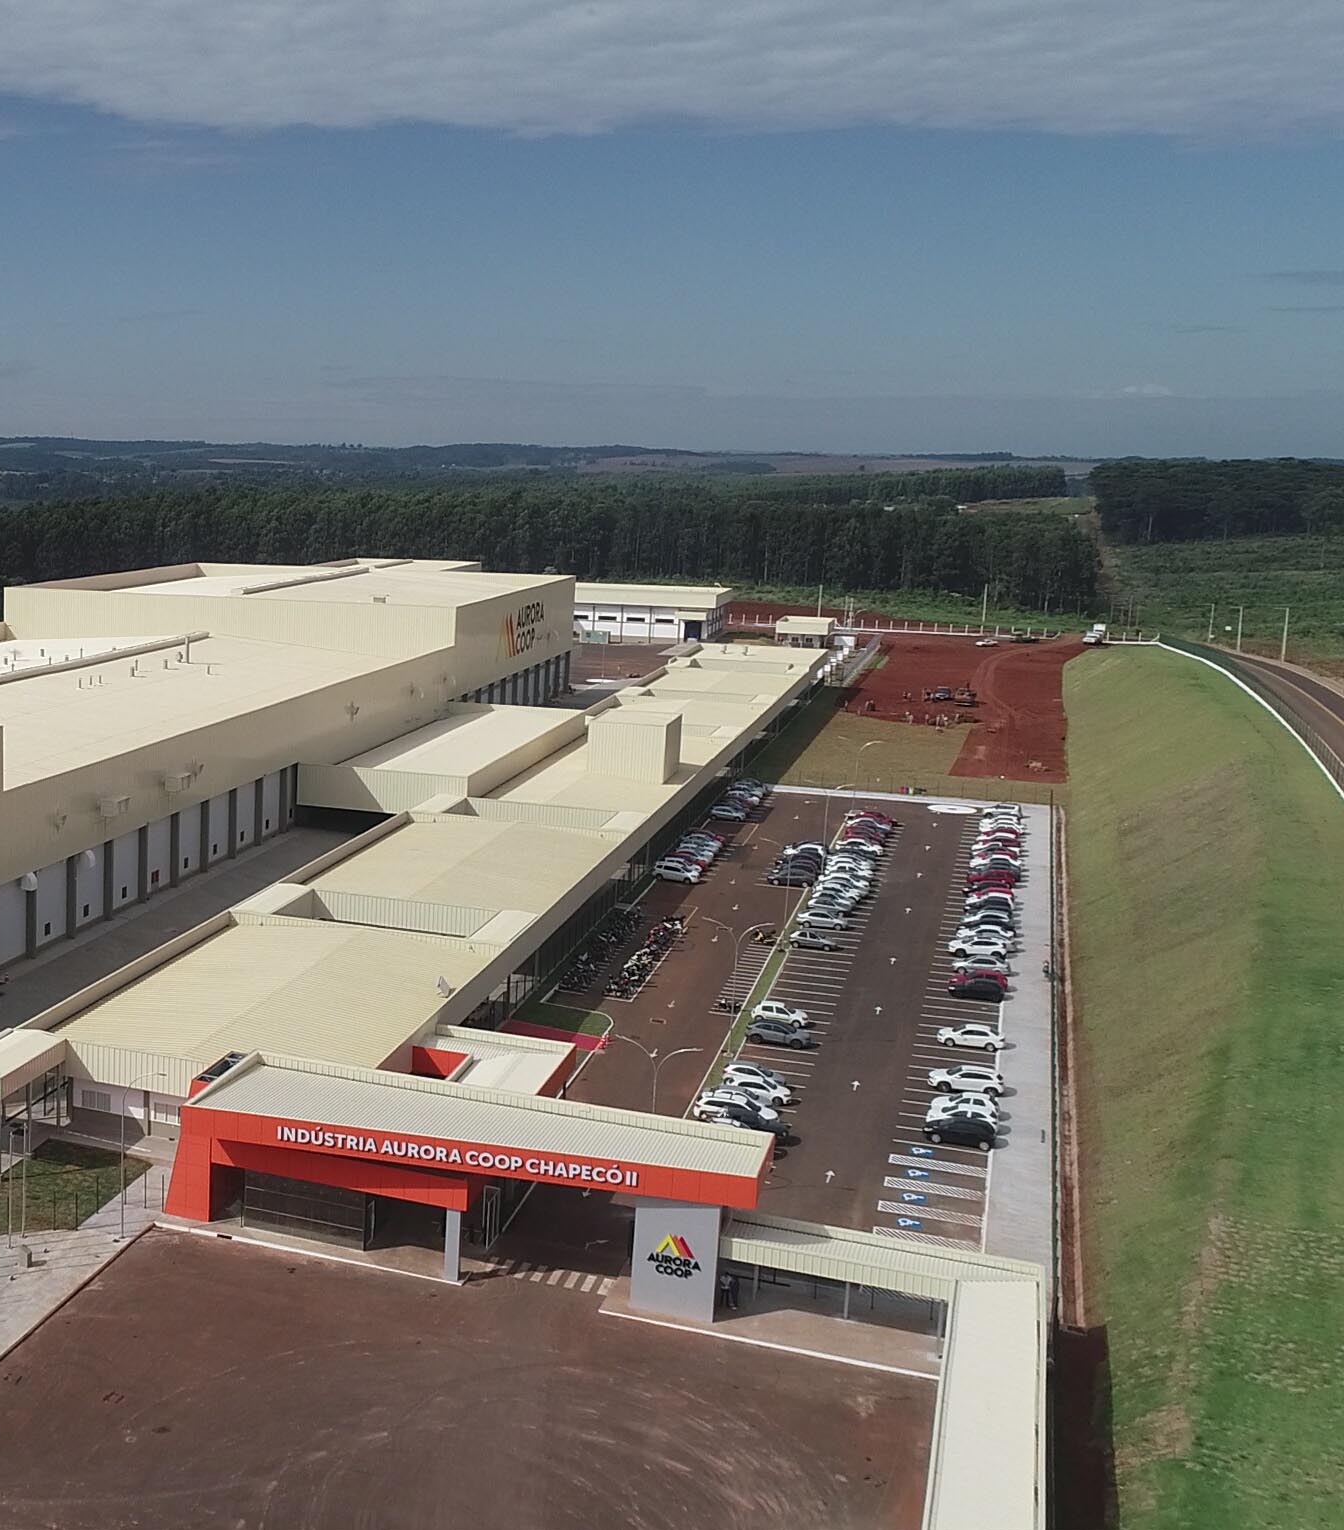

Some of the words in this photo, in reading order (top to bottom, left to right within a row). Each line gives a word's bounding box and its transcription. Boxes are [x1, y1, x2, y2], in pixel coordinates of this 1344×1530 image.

[516, 602, 544, 630] AURORA
[516, 628, 535, 654] COOP
[277, 1126, 377, 1153] INDÚSTRIA
[381, 1140, 462, 1164] AURORA
[465, 1151, 522, 1171] COOP
[525, 1158, 623, 1184] CHAPECÓ
[625, 1171, 638, 1187] II
[647, 1252, 701, 1272] AURORA
[655, 1264, 693, 1279] COOP
